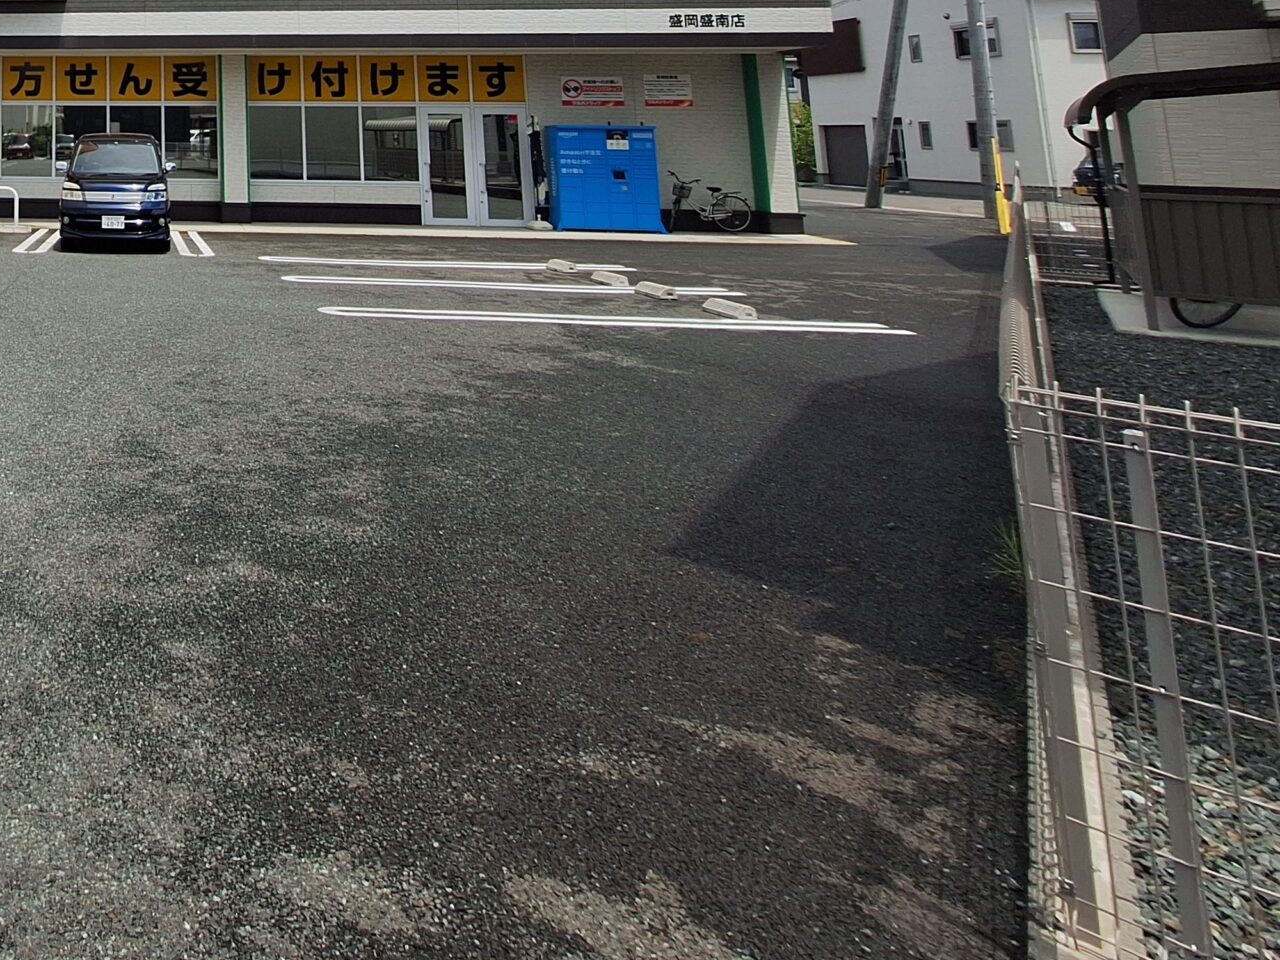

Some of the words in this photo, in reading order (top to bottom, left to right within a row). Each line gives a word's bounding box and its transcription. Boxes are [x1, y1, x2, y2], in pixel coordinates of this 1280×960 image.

[668, 13, 746, 28] 盛岡盛南店
